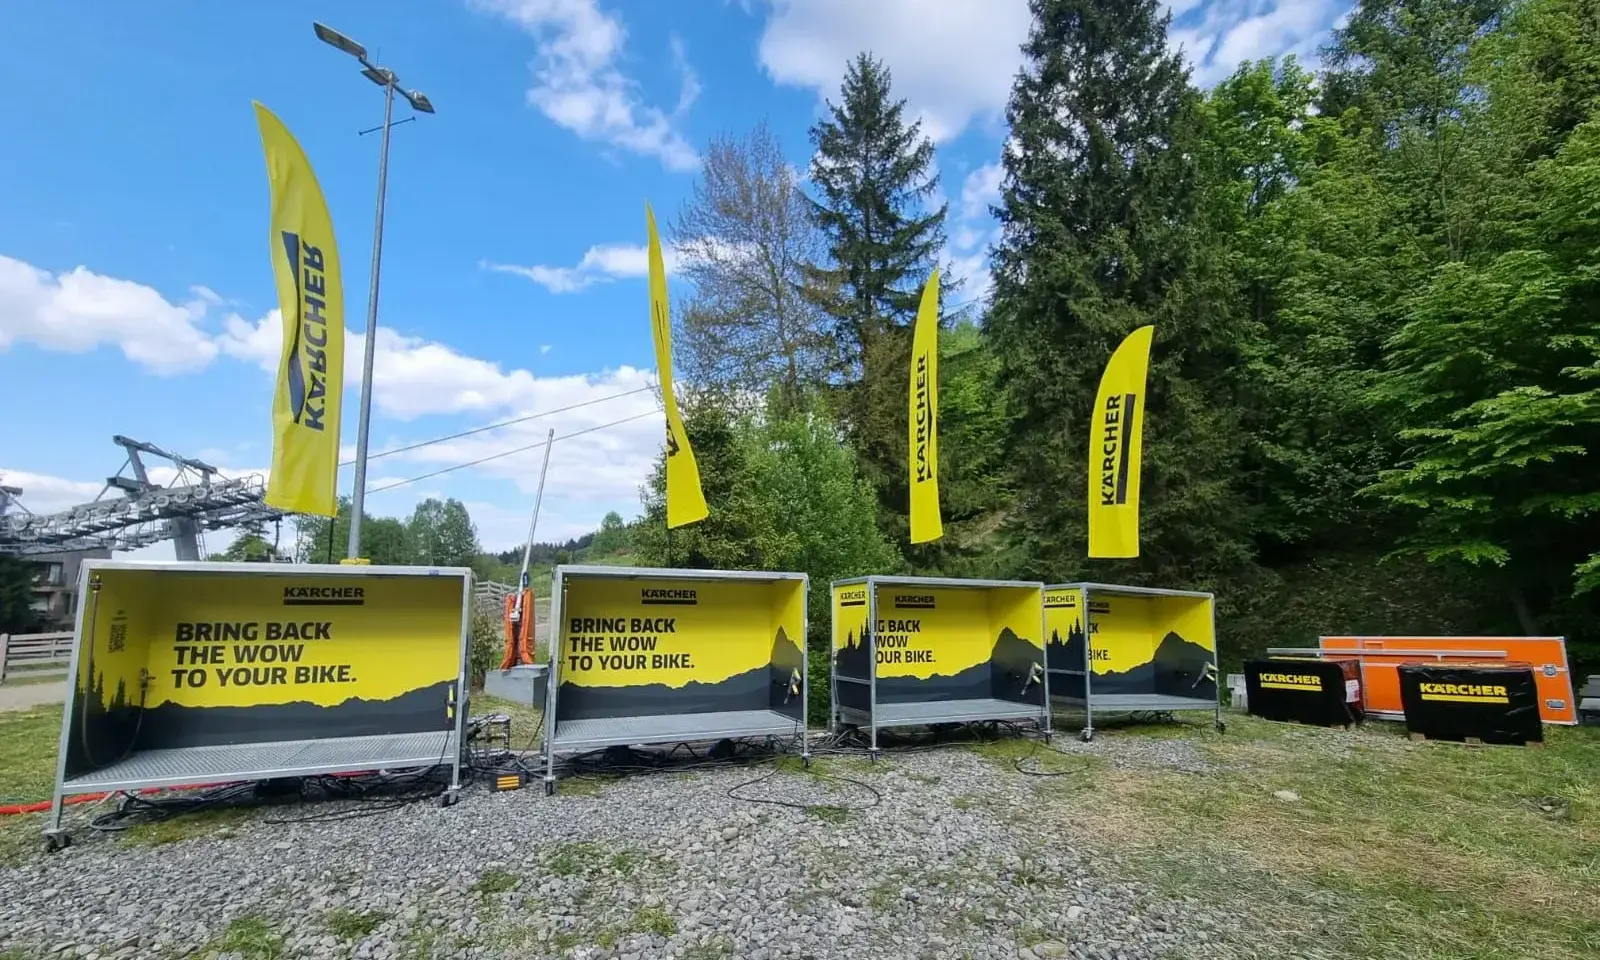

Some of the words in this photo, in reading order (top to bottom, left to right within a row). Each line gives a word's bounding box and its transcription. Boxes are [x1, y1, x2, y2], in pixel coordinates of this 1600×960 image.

[917, 355, 926, 483] KÄRCHER
[1101, 395, 1121, 505] KÄRCHER
[284, 587, 365, 598] KÄRCHER
[641, 588, 697, 599] KÄRCHER
[175, 622, 259, 642] BRING
[265, 621, 332, 641] BACK
[570, 618, 625, 633] BRING
[631, 618, 676, 633] BACK
[888, 619, 921, 633] BACK
[569, 636, 604, 652] THE
[609, 636, 657, 651] WOW
[173, 645, 226, 665] THE
[233, 644, 304, 664] WOW
[876, 650, 902, 664] OUR
[905, 650, 936, 663] BIKE.
[569, 655, 592, 671] TO
[599, 654, 647, 671] YOUR
[652, 654, 695, 669] BIKE.
[171, 668, 207, 689] TO
[216, 667, 287, 687] YOUR
[294, 665, 357, 684] BIKE.
[1259, 673, 1321, 685] KÄRCHER
[1420, 683, 1508, 696] KÄRCHER
